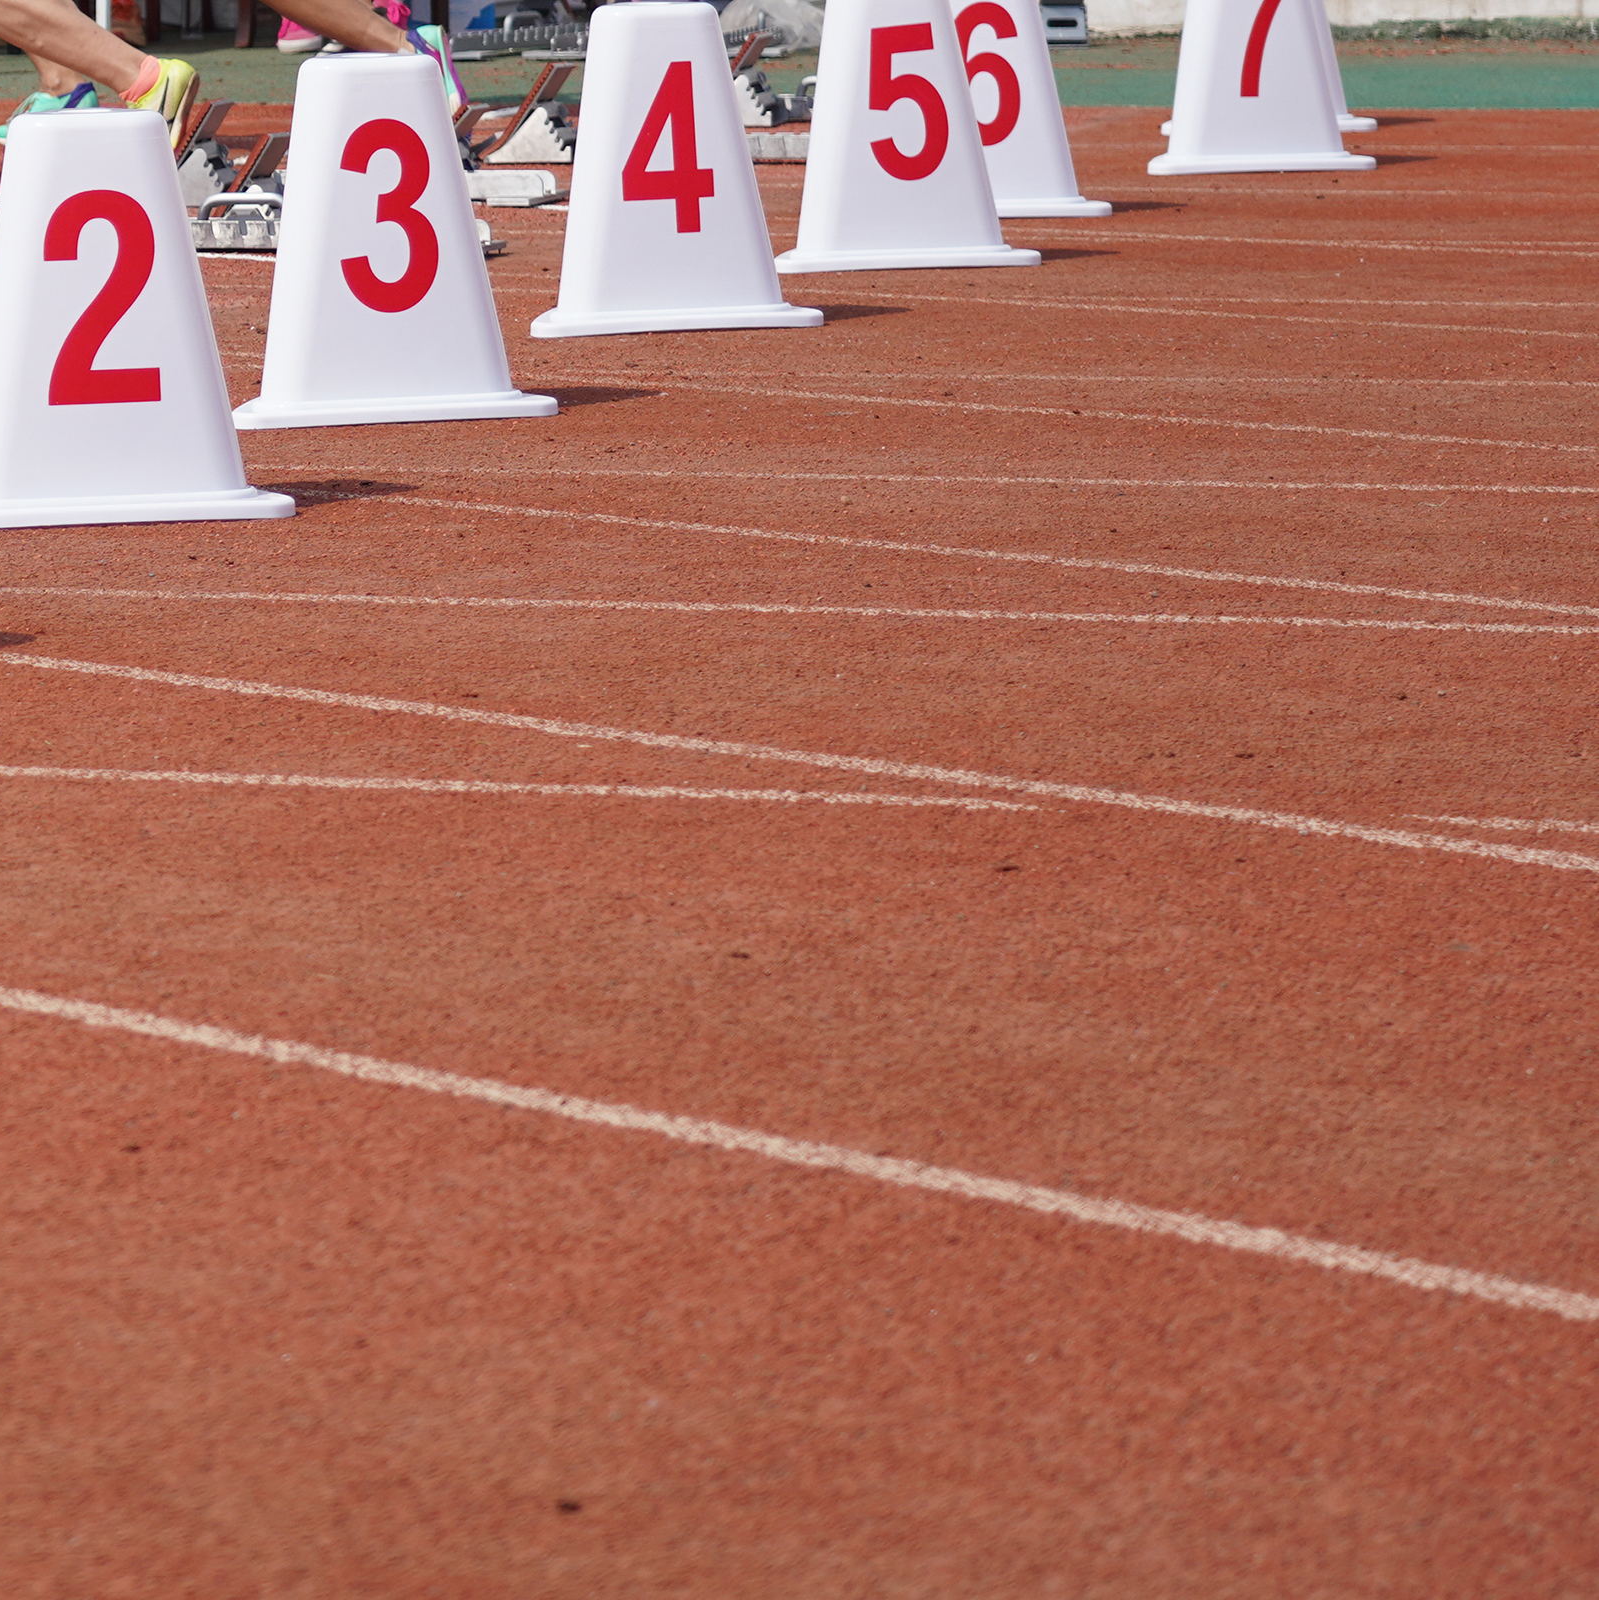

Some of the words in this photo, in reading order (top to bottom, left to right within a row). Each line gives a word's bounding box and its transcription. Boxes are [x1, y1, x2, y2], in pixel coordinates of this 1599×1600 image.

[622, 61, 715, 233] 4
[869, 22, 949, 181] 5
[955, 2, 1021, 147] 6
[43, 190, 162, 406] 2
[340, 118, 439, 313] 3
